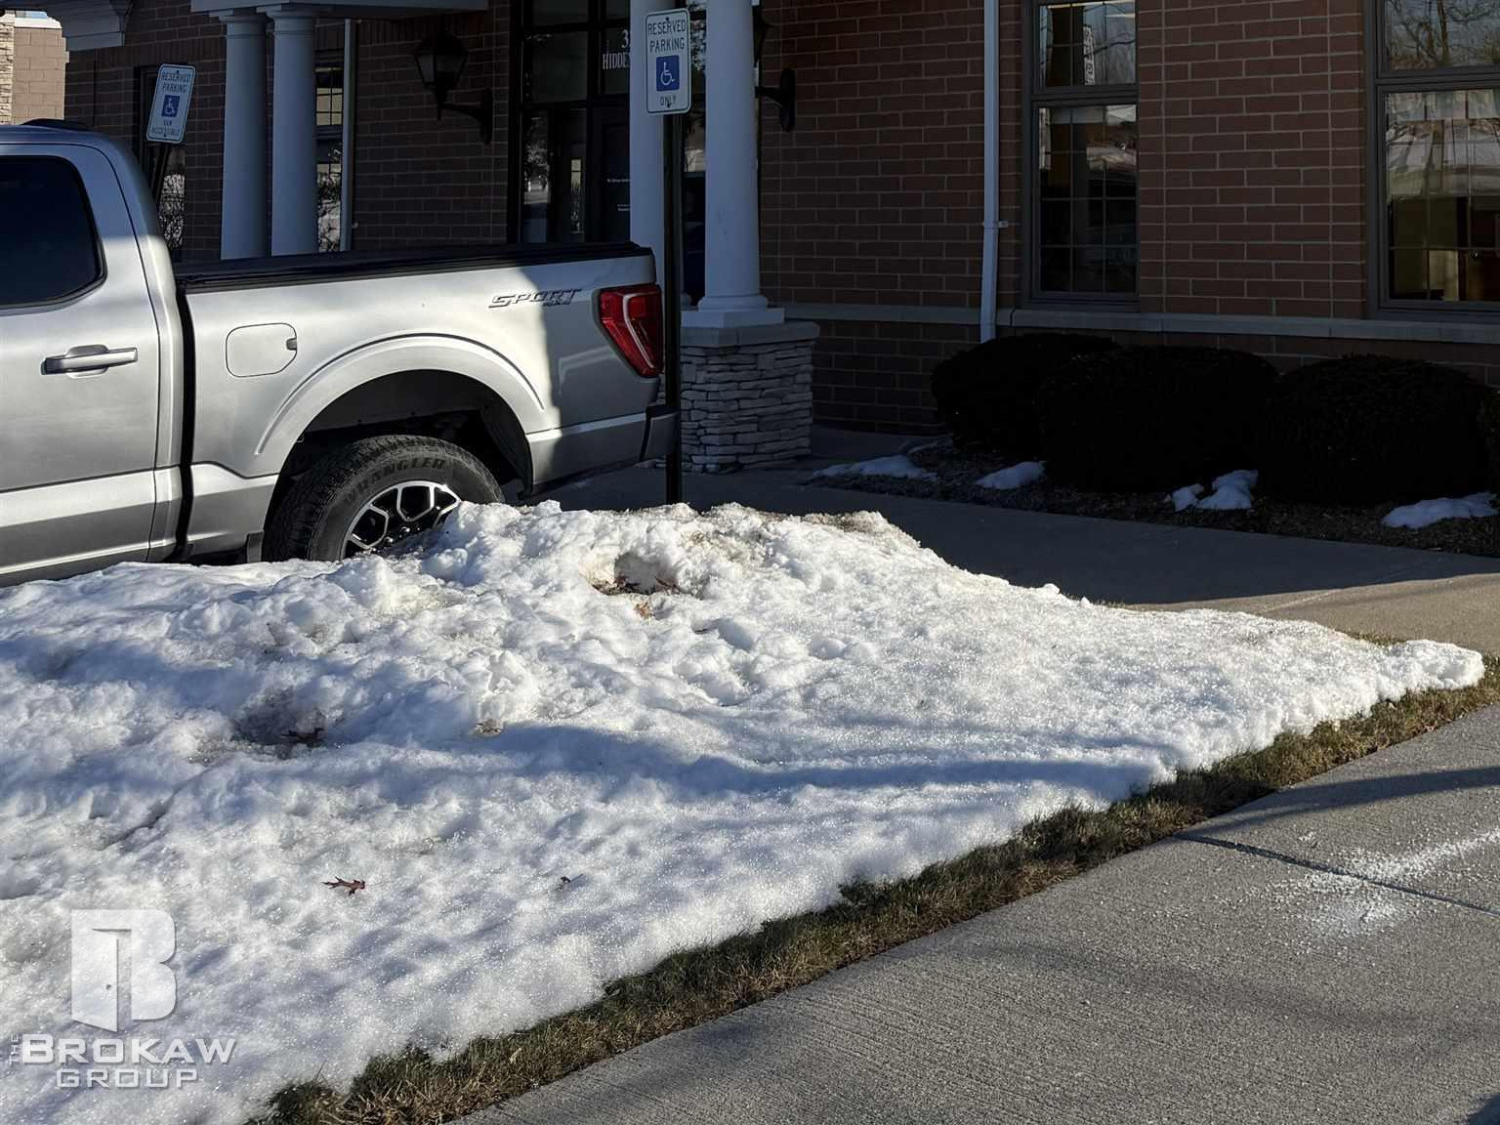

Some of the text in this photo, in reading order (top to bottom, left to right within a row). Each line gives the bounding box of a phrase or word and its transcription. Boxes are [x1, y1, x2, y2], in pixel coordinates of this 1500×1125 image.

[648, 19, 686, 35] RESERVED
[649, 37, 685, 53] PARKING
[602, 52, 630, 70] HIDDE
[660, 96, 677, 107] ONLY
[488, 288, 582, 308] SPORT
